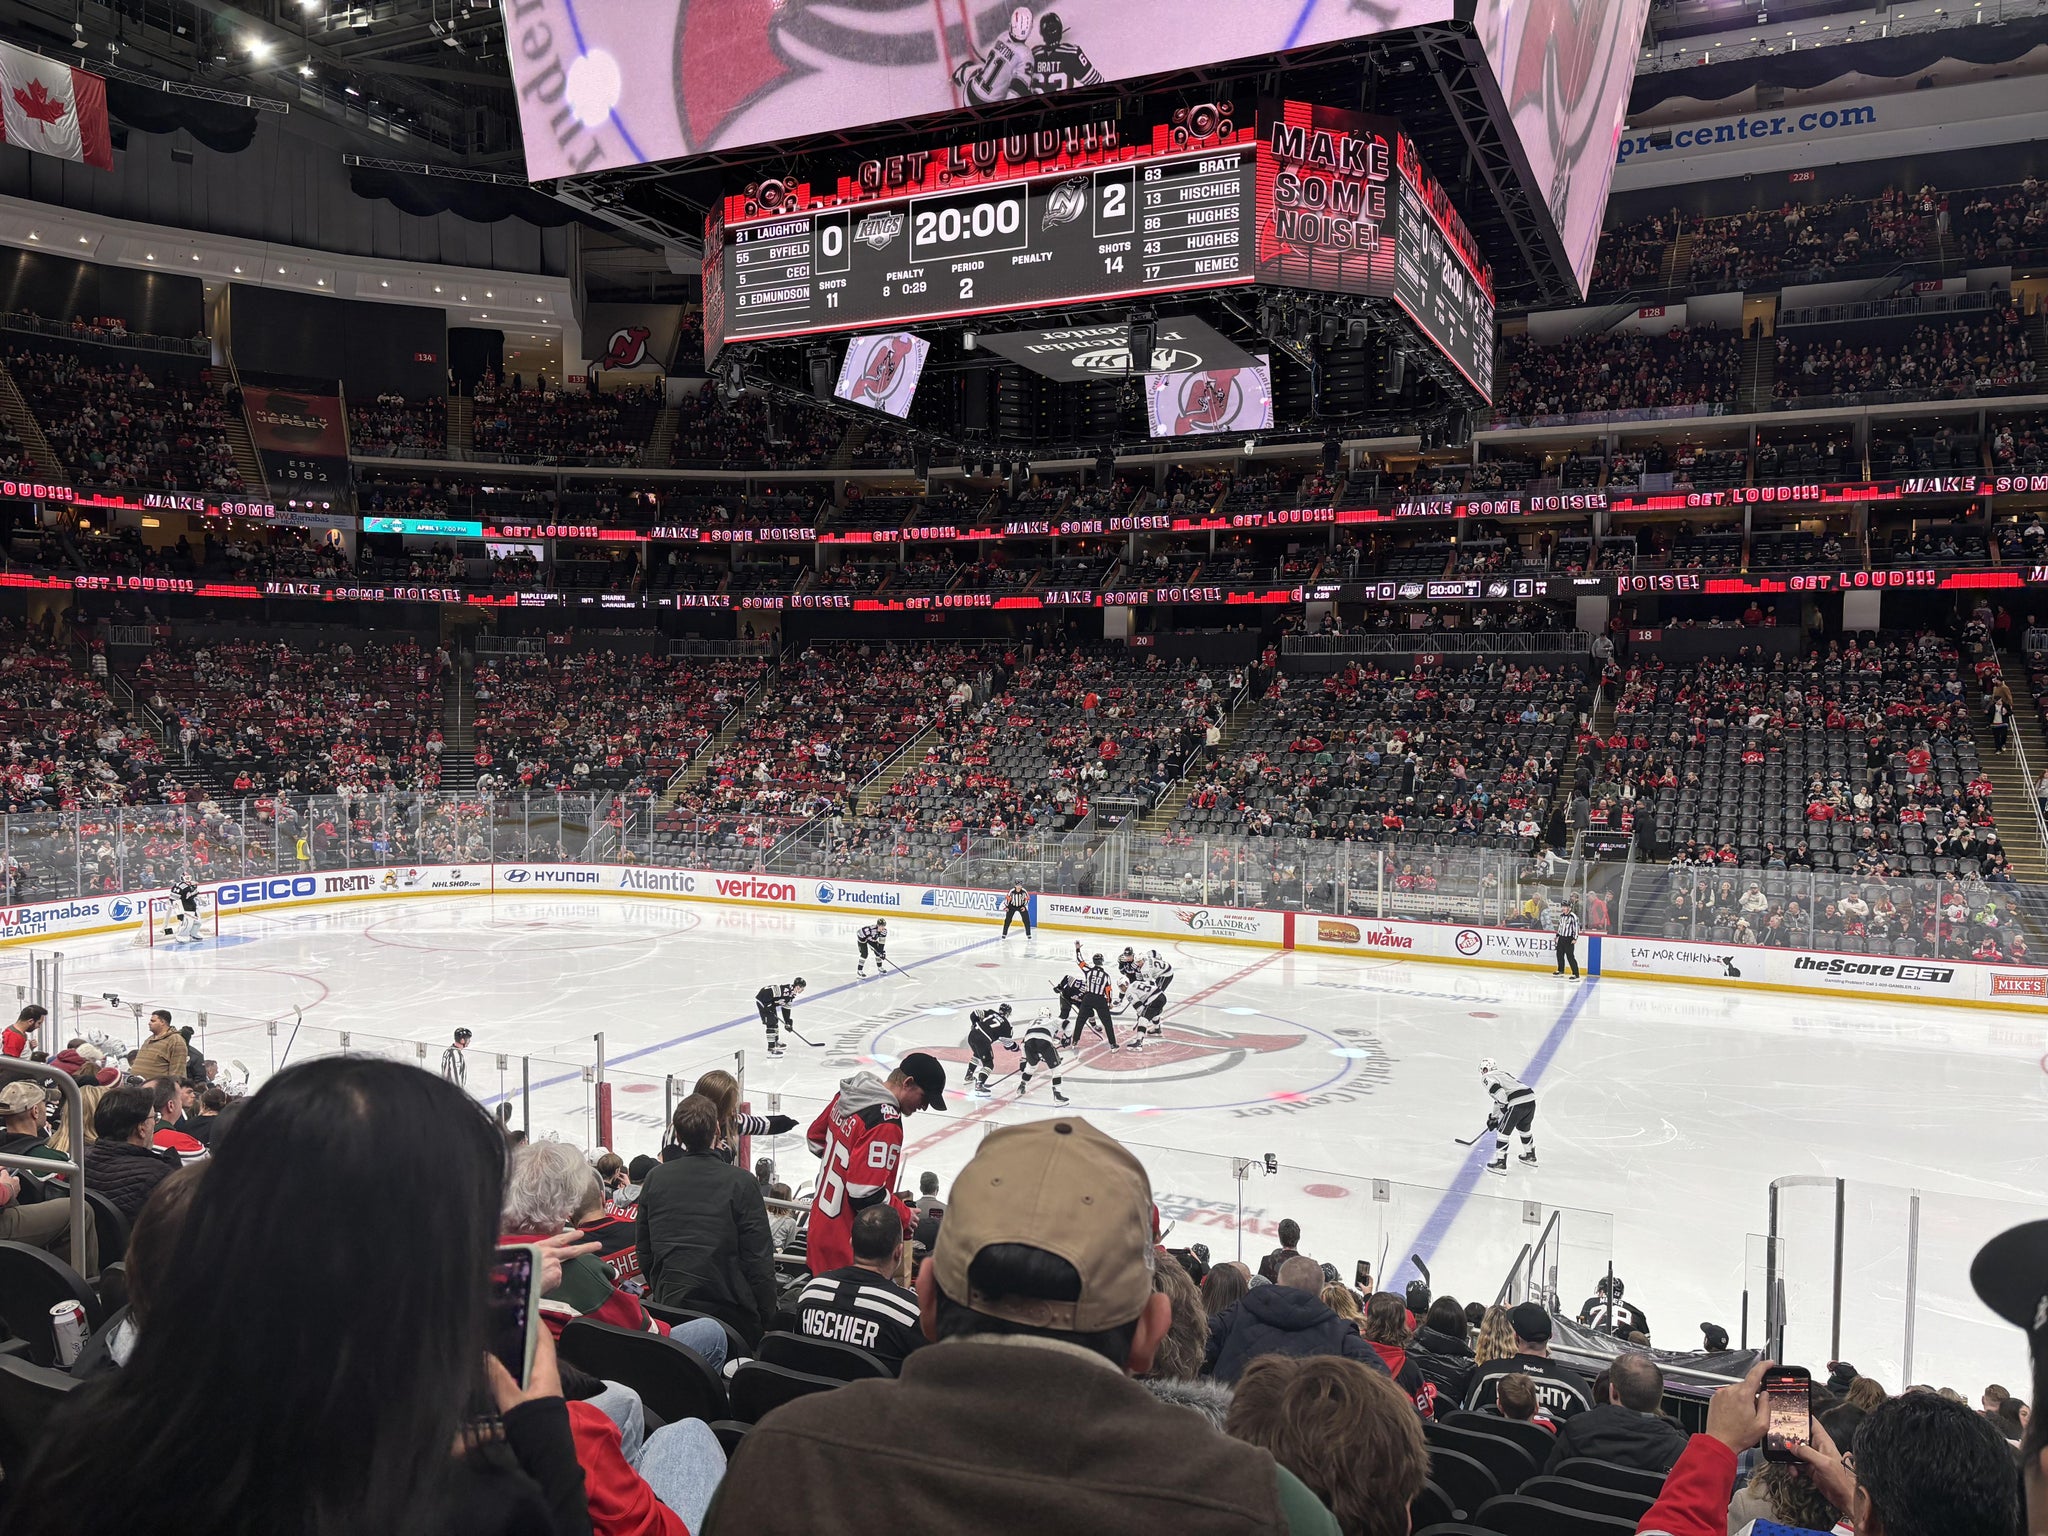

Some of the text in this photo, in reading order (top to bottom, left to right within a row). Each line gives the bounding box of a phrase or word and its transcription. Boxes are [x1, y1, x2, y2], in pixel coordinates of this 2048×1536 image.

[1037, 61, 1061, 73] BRATT
[1271, 121, 1390, 181] MAKE
[858, 151, 928, 189] GET
[1199, 157, 1241, 174] BRATT
[1144, 169, 1162, 182] 63
[1793, 172, 1810, 182] 228
[1103, 183, 1126, 218] 2
[1146, 182, 1240, 205] 13 HISCHIER
[1275, 171, 1386, 218] SOME
[915, 199, 1020, 246] 20:00
[1144, 207, 1240, 230] 86 HUGHES
[736, 221, 810, 242] 21 LAUGHTON
[859, 217, 901, 237] KINGS
[1275, 208, 1379, 252] NOISE!
[822, 226, 843, 257] 0
[1098, 242, 1131, 254] SHOTS
[1144, 232, 1239, 253] 43 HUGHES
[736, 243, 810, 264] 55 BYFIELD
[1012, 252, 1053, 265] PENALTY
[951, 261, 984, 273] PERIOD
[1105, 256, 1124, 274] 14
[1145, 257, 1239, 279] 17 NEMEC
[739, 265, 810, 285] 5 CECI
[886, 269, 924, 282] PENALTY
[819, 279, 847, 290] SHOTS
[883, 282, 927, 297] 8 0:29
[959, 278, 974, 299] 2
[751, 287, 810, 305] EDMUNDSON
[826, 293, 839, 308] 11
[1644, 308, 1660, 317] 128
[418, 353, 432, 362] 134
[572, 376, 585, 384] 133
[257, 416, 328, 430] JERSEY
[289, 460, 321, 469] EST.
[277, 469, 328, 482] 1982
[0, 481, 73, 500] OUD!!!
[1902, 476, 1976, 493] MAKE
[1688, 485, 1819, 507] GET LOUD!!!
[143, 493, 276, 518] MAKE SOME
[1396, 493, 1608, 516] MAKE SOME NOISE!
[1005, 515, 1170, 534] MAKE SOME NOISE!
[1233, 508, 1335, 527] GET LOUD!!!
[503, 525, 598, 538] GET LOUD!!!
[651, 526, 816, 542] MAKE SOME NOISE!
[872, 526, 956, 542] GET LOUD!!!
[75, 576, 194, 592] GET LOUD!!!
[1619, 574, 1699, 591] NOISE!
[1790, 570, 1936, 590] GET LOUD!!!
[265, 582, 320, 595] MAKE
[335, 588, 384, 601] SOME
[1044, 588, 1221, 604] MAKE SOME NOISE!
[1382, 586, 1390, 597] 0
[1430, 585, 1462, 596] 20:00
[1519, 583, 1527, 594] 2
[1536, 587, 1546, 595] 14
[681, 595, 730, 607] MAKE
[742, 597, 784, 609] SOME
[791, 595, 850, 607] NOISE!
[906, 594, 992, 608] GET LOUD!!!
[930, 614, 939, 622] 21
[554, 636, 564, 644] 22
[1137, 637, 1147, 645] 20
[1638, 631, 1651, 640] 18
[1423, 655, 1434, 664] 19
[535, 871, 599, 883] HYUNDAI
[619, 869, 695, 892] Atlantic
[217, 877, 317, 906] GEICO
[715, 877, 796, 902] verizon
[837, 888, 901, 906] Prudential
[934, 889, 998, 911] HALMAR
[1050, 904, 1109, 915] STREAM LIVE
[1367, 929, 1412, 949] Wawa
[1486, 935, 1557, 951] F.W. WEBB
[1501, 948, 1540, 958] COMPANY
[1631, 948, 1710, 963] EAT MOR CHIKIN
[1794, 957, 1950, 982] theScore BET
[1998, 980, 2042, 991] MIKE'S
[868, 1140, 901, 1171] 86
[801, 1307, 880, 1349] HISCHIER
[1523, 1364, 1544, 1373] Reebok
